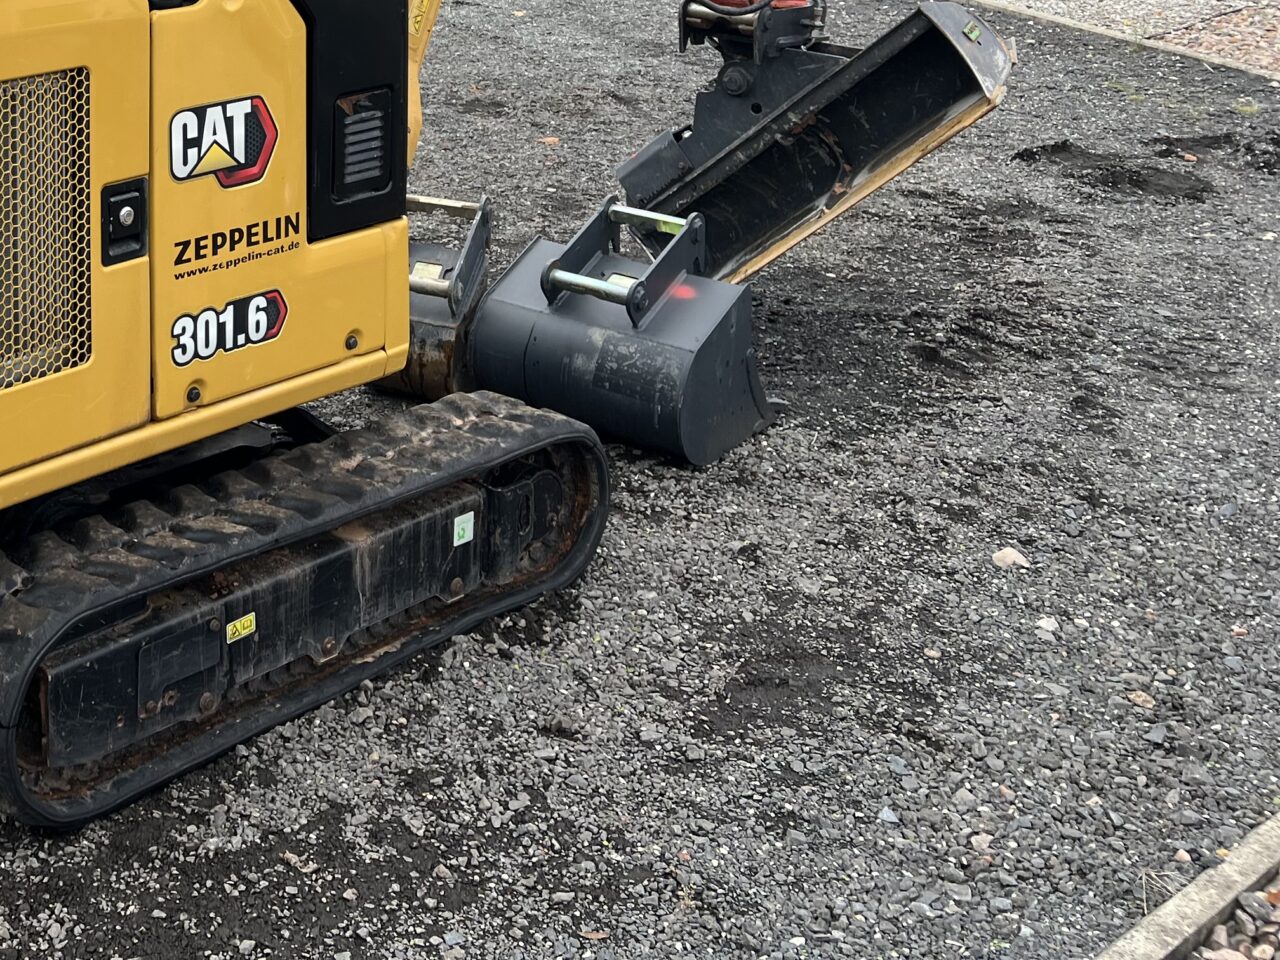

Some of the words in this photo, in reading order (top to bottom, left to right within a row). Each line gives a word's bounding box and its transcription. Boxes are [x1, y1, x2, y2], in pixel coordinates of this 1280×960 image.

[170, 99, 252, 179] CAT
[173, 212, 301, 267] ZEPPELIN
[173, 240, 301, 281] www.zeppelin-cat.de
[172, 295, 269, 364] 301.6
